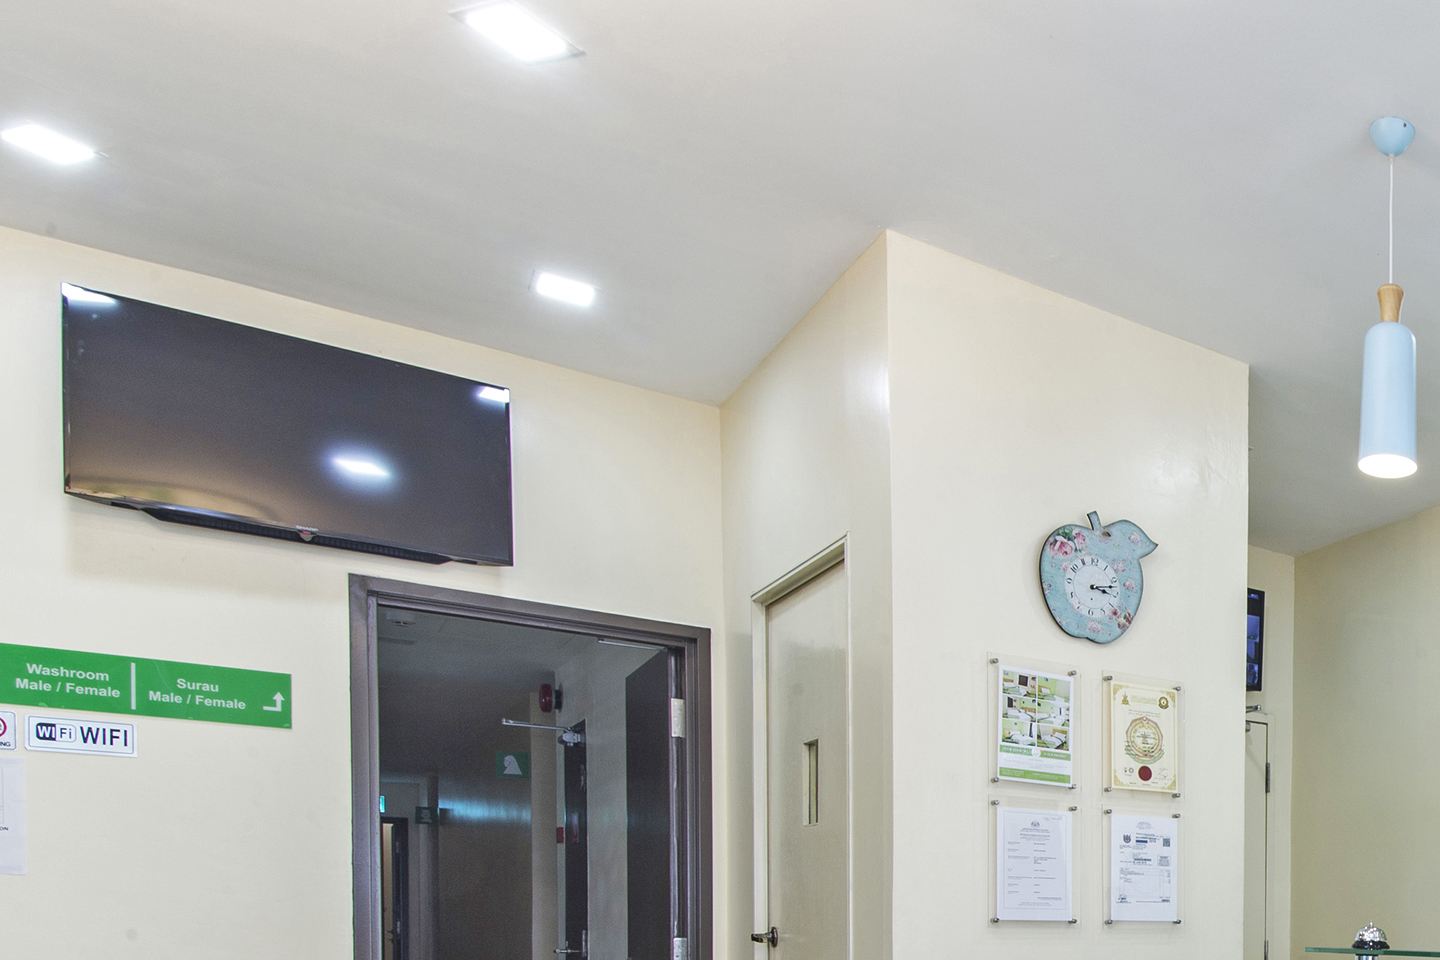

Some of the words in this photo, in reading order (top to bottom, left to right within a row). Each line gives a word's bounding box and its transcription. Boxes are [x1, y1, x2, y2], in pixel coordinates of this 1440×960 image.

[26, 663, 109, 681] Washroom
[15, 677, 52, 691] Male
[65, 682, 121, 698] Female
[176, 678, 219, 693] Surau
[149, 690, 183, 704] Male
[195, 695, 246, 709] Female
[80, 726, 128, 747] WIFI
